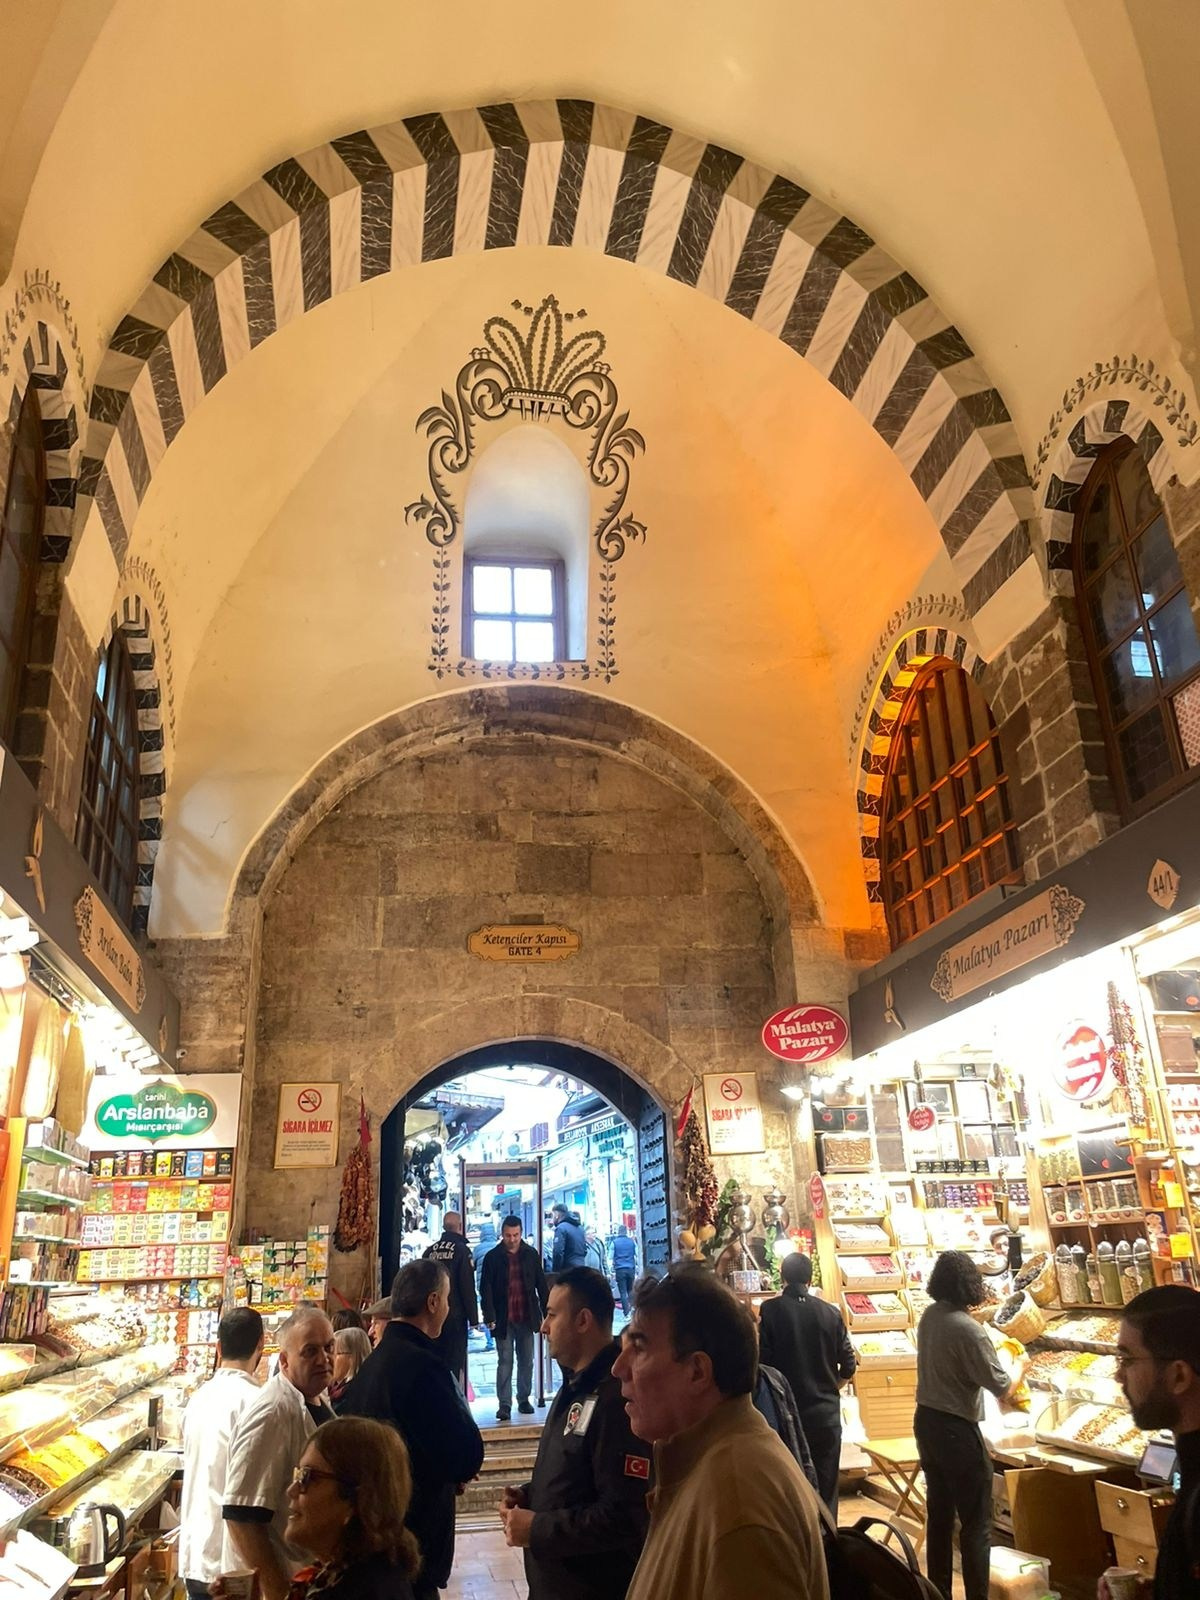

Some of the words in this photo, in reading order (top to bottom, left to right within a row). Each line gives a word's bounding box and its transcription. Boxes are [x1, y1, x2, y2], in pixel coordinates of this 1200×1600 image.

[483, 933, 533, 945] Ketenciler
[535, 934, 567, 948] Kapısı
[952, 940, 1000, 979] Malatya
[1003, 914, 1049, 950] Pazarı
[508, 946, 533, 956] GATE
[535, 946, 541, 955] 4
[770, 1020, 836, 1037] Malatya
[779, 1035, 834, 1050] Pazarı
[102, 1103, 209, 1120] Arslanbaba
[283, 1119, 307, 1134] SİGARA
